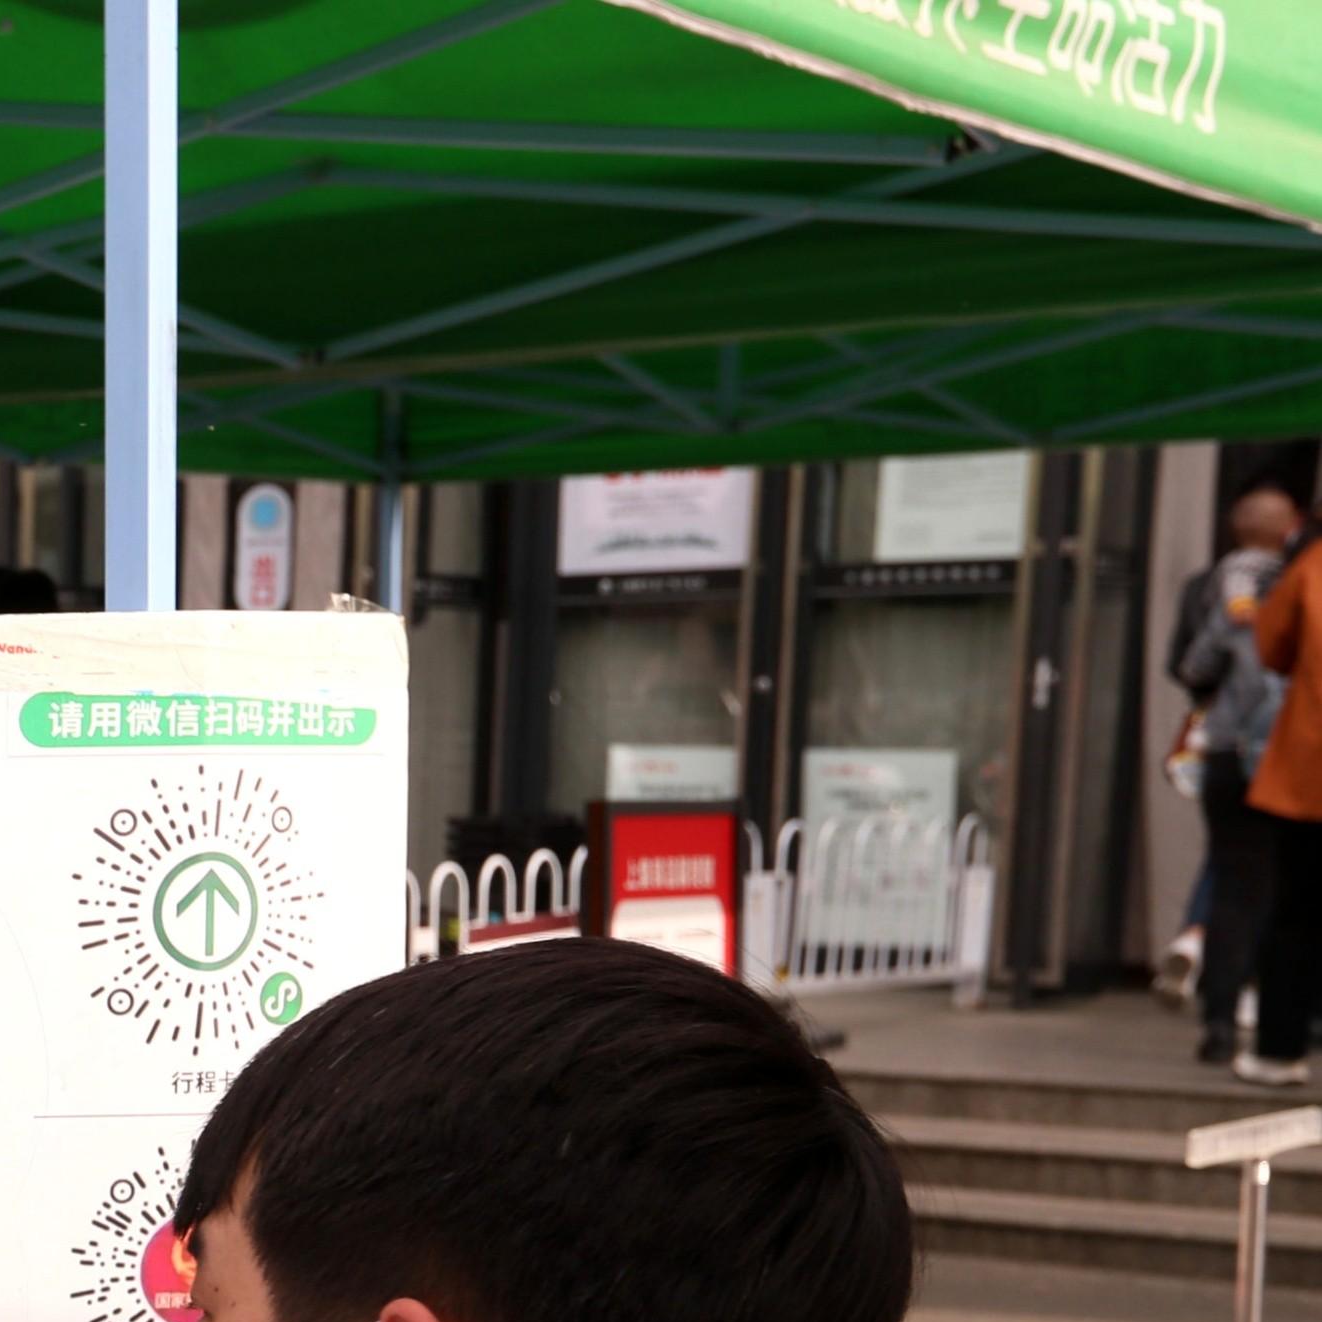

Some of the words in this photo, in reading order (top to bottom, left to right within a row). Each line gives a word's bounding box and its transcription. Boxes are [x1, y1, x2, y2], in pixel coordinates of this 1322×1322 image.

[824, 0, 1226, 135] 生命活力
[48, 698, 356, 739] 请用微信扫码并出示
